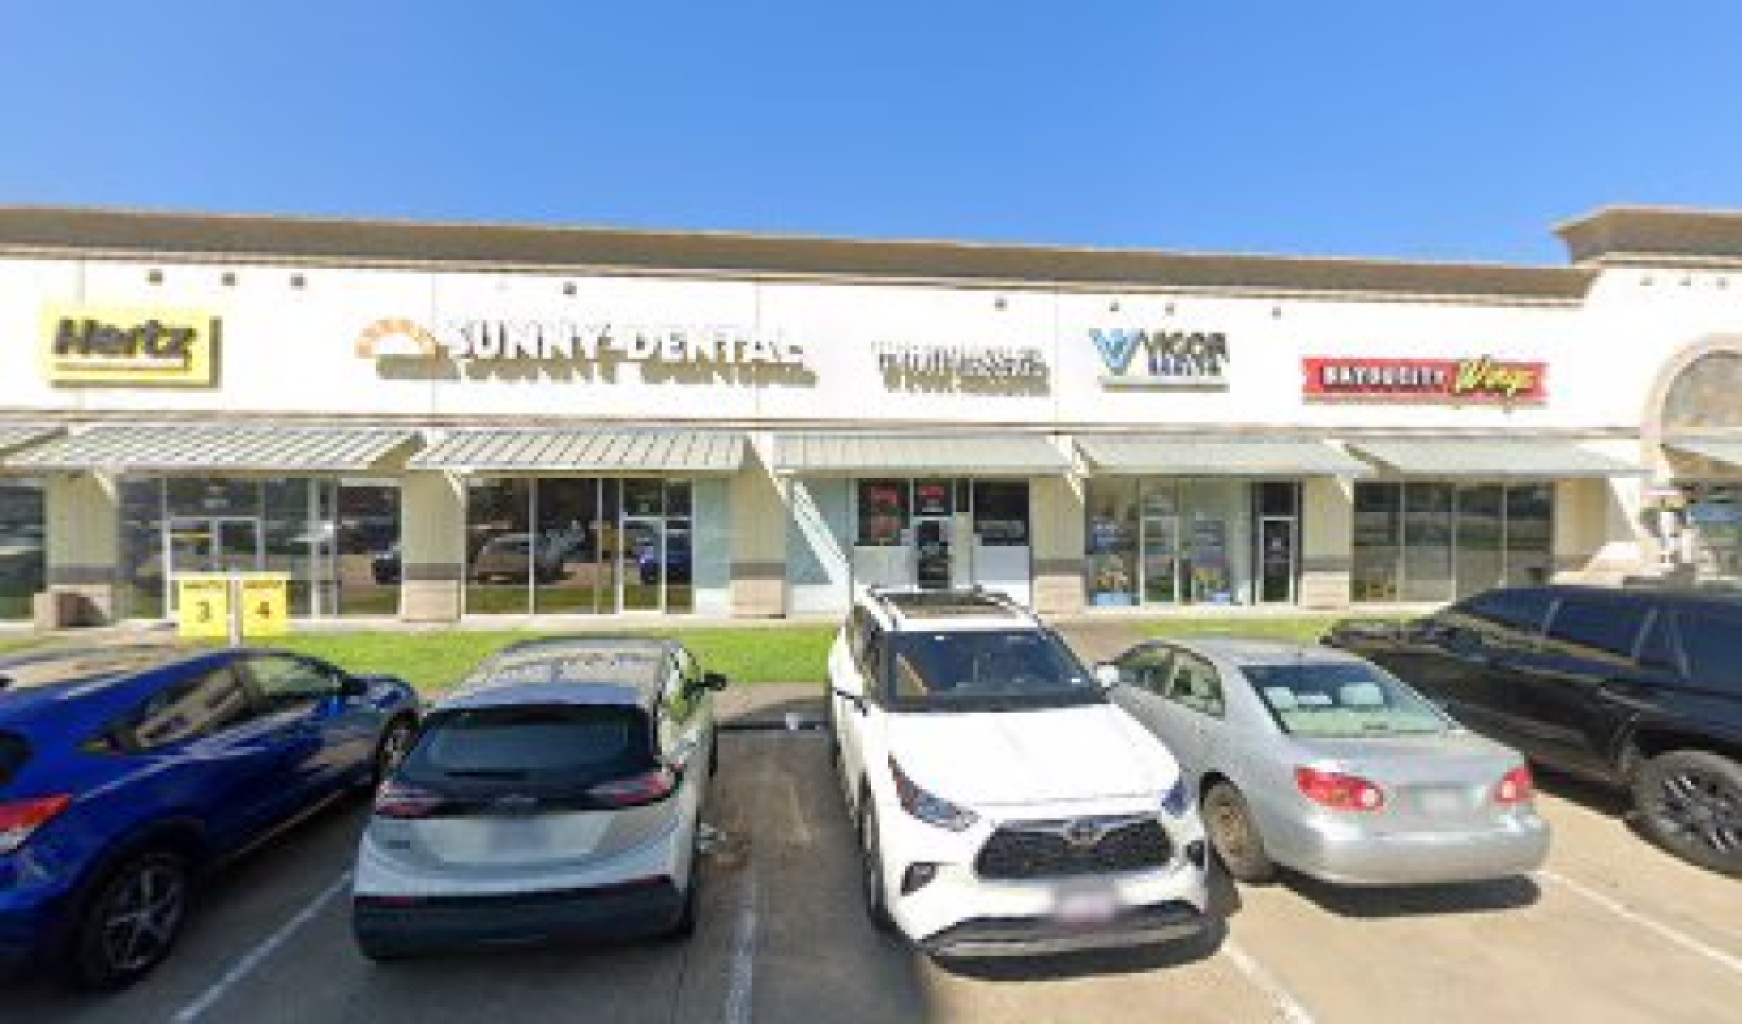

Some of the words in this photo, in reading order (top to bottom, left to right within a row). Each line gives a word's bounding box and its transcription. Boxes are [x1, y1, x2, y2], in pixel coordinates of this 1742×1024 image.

[54, 318, 196, 356] Hertz
[446, 320, 613, 360] SUNNY
[626, 326, 805, 363] DENTAL
[1143, 331, 1229, 359] VIGOR
[195, 601, 213, 623] 3
[255, 601, 273, 621] 4
